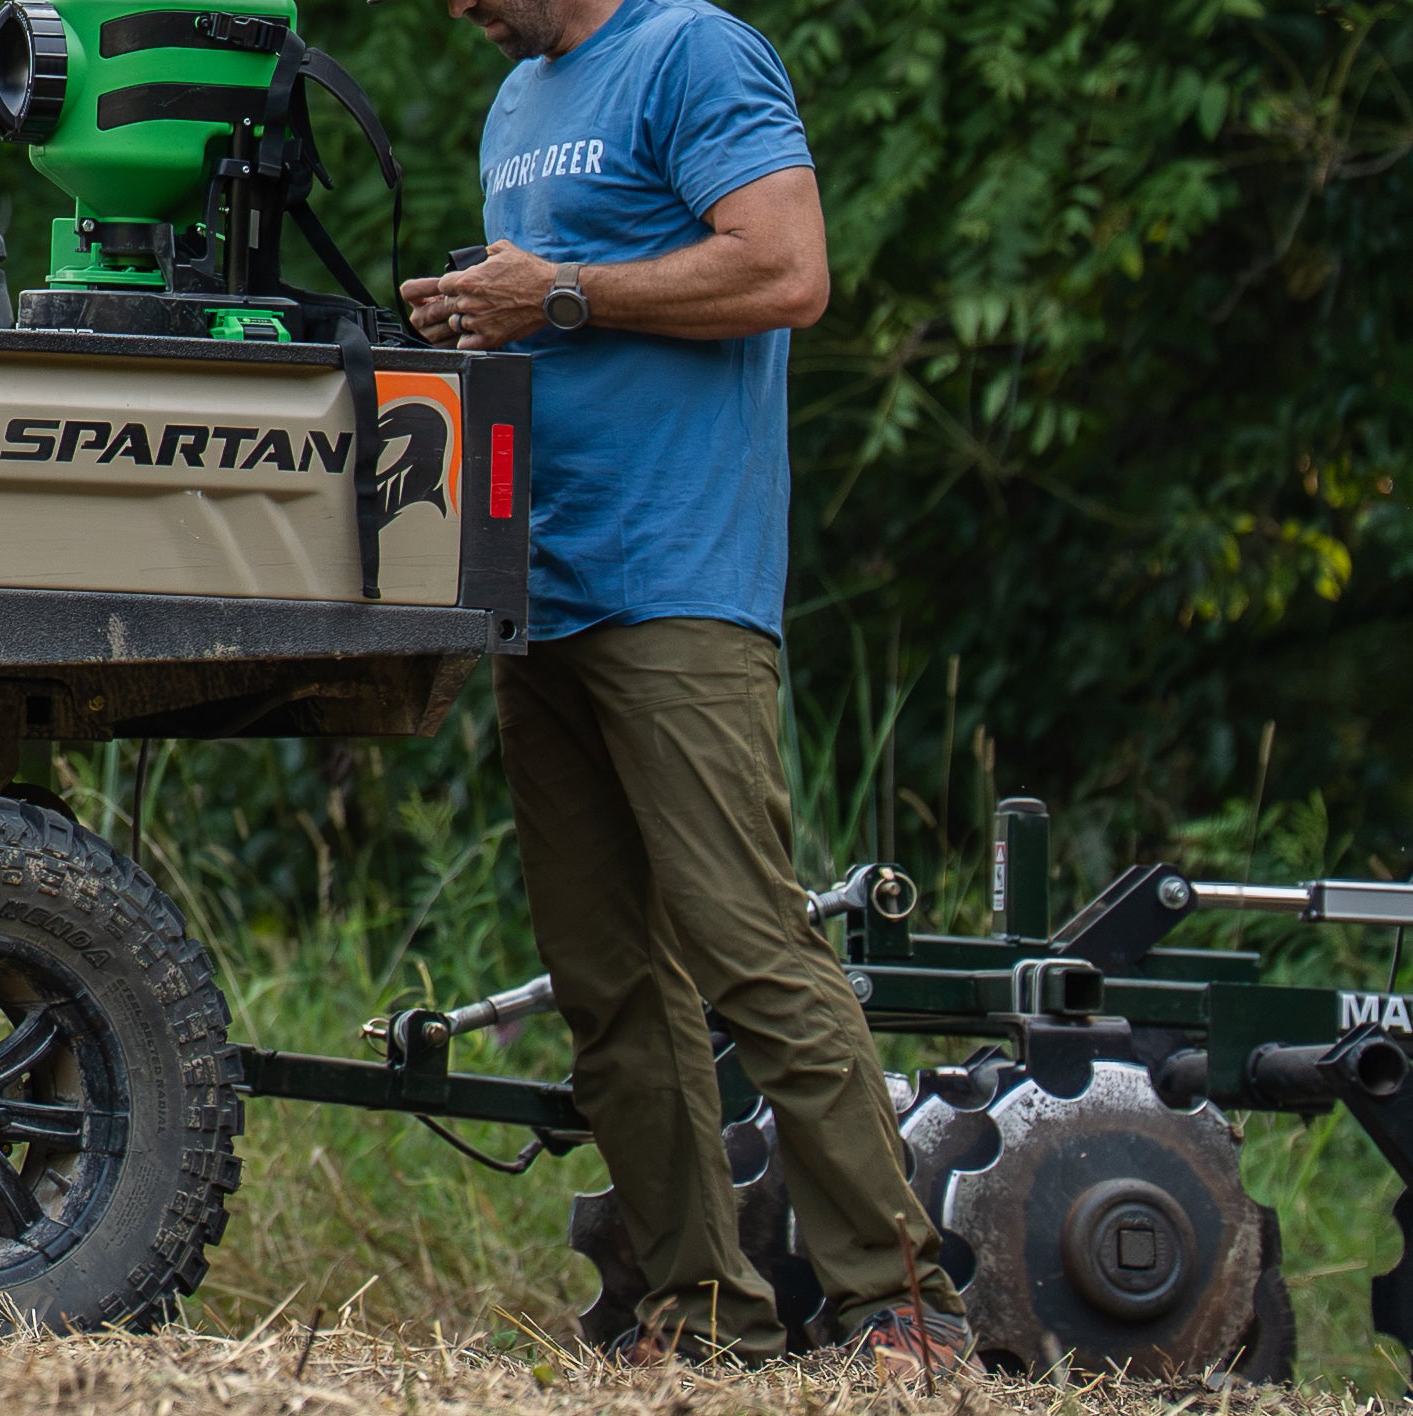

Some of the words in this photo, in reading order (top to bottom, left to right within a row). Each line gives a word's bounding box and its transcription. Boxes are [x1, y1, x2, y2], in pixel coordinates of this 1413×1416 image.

[492, 148, 541, 193] MORE
[541, 138, 604, 178] DEER
[0, 417, 354, 474] SPARTAN
[1340, 993, 1413, 1034] MA
[140, 1019, 163, 1076] BELTED
[154, 1078, 167, 1135] RADIAL
